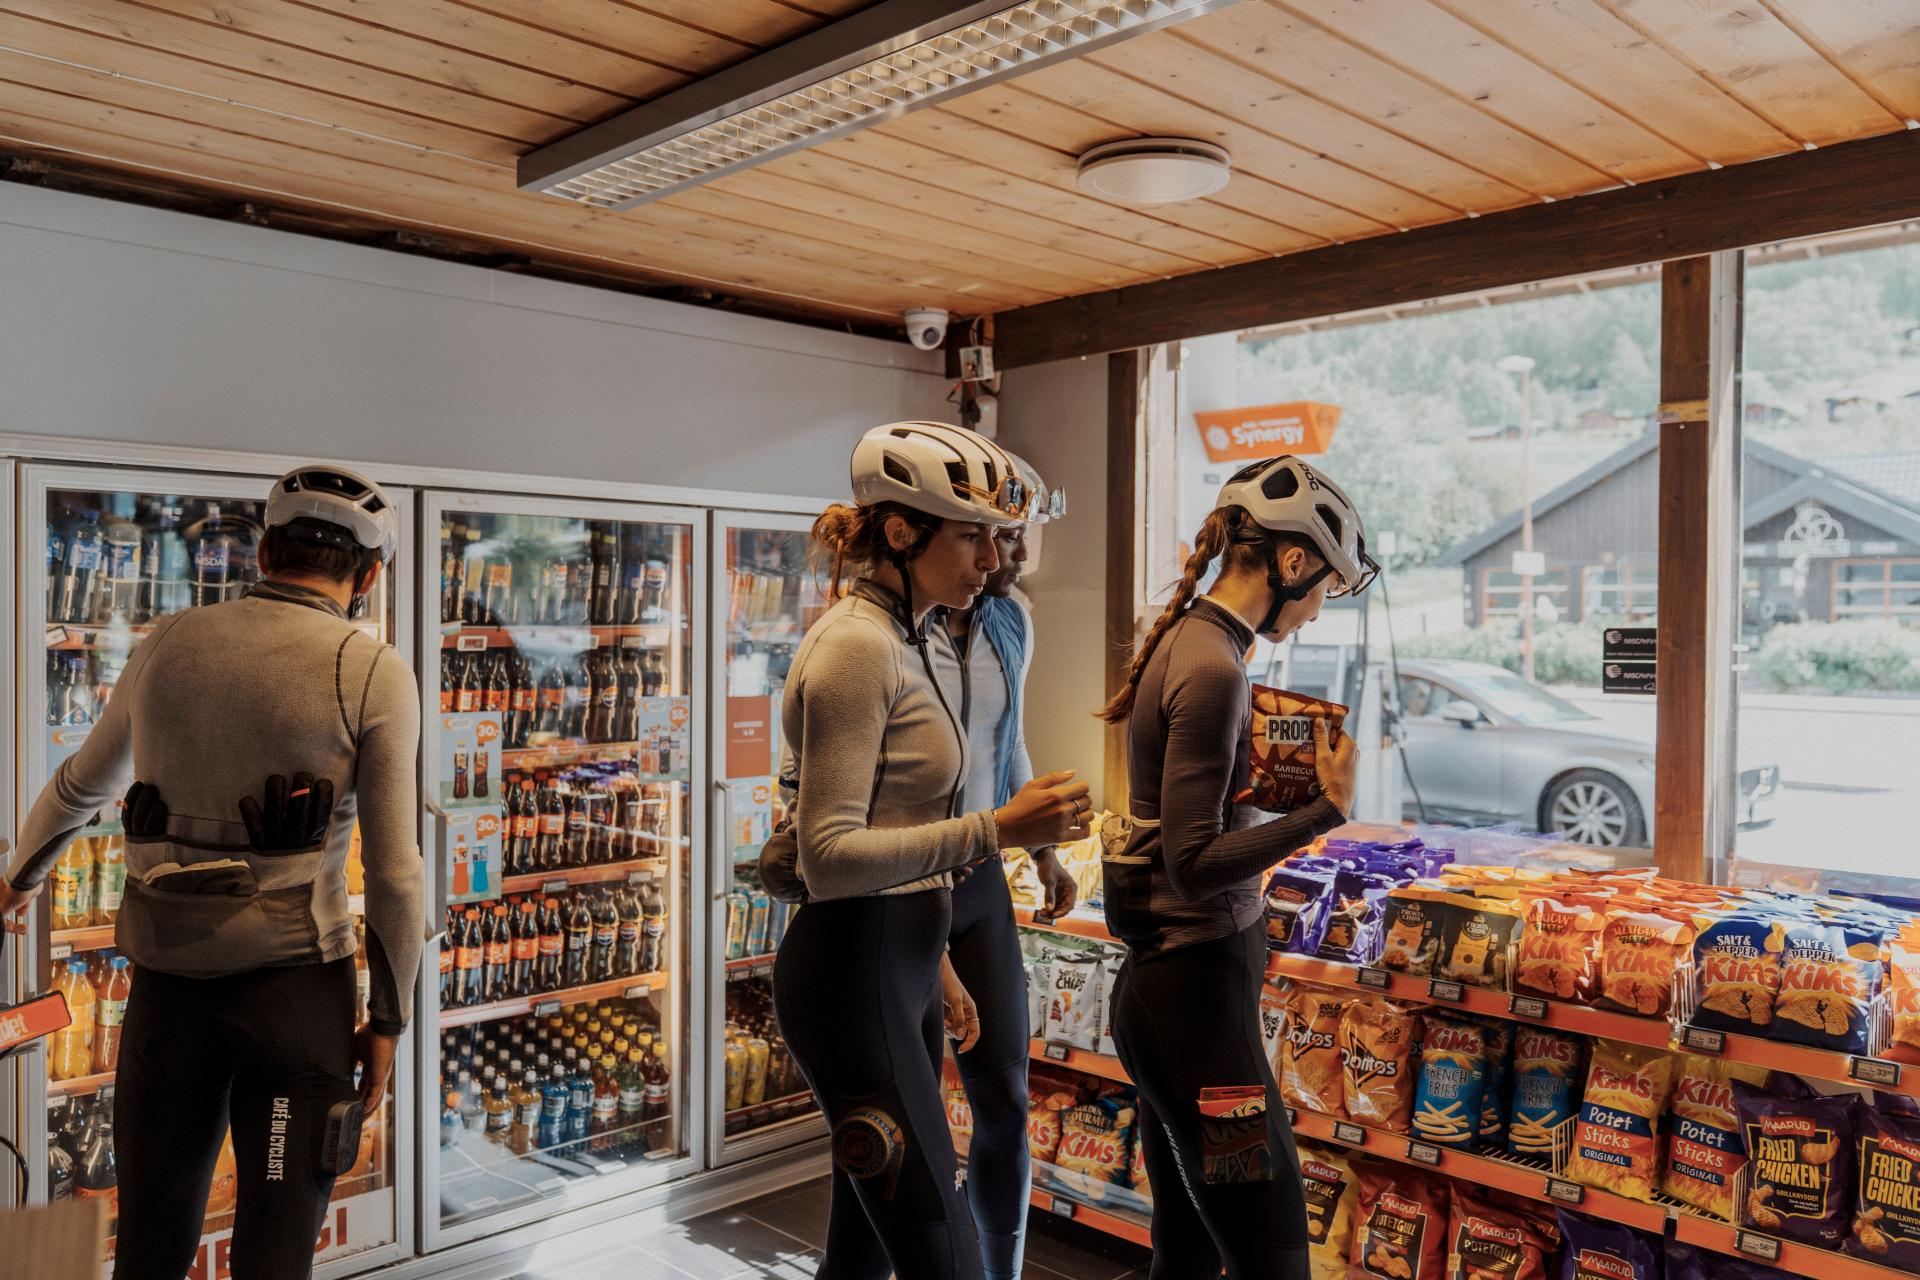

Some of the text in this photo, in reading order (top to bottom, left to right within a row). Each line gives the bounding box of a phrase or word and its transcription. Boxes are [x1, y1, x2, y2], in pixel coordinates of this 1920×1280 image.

[1232, 424, 1304, 448] Synergy
[1297, 463, 1319, 491] POC
[1274, 763, 1315, 776] BARBECUE
[1528, 911, 1571, 925] MXICAN
[1713, 945, 1758, 958] PEPPER
[1790, 949, 1838, 963] PEPPER
[1056, 977, 1086, 992] CHIPS
[1319, 1002, 1342, 1010] BOLD
[1425, 1064, 1468, 1085] FRENCH
[1429, 1080, 1459, 1098] FRIES
[1519, 1076, 1561, 1094] FRENCH
[1522, 1091, 1553, 1109] FRIES
[1589, 1106, 1633, 1131] Potet
[1763, 1119, 1811, 1132] MAARUD
[266, 1097, 291, 1181] CAFÉ DU CYCLISTE
[1584, 1126, 1630, 1149] Sticks
[1680, 1121, 1726, 1148] Potet
[1584, 1149, 1626, 1166] ORIGINAL
[1675, 1140, 1724, 1168] Sticks
[1758, 1137, 1796, 1162] FRIED
[1302, 1163, 1338, 1179] MAARUD
[1675, 1163, 1718, 1184] ORIGINAL
[1757, 1160, 1820, 1189] CHICKEN
[1870, 1152, 1913, 1183] FRIED
[1383, 1198, 1416, 1214] MAARUD
[1471, 1223, 1516, 1240] MAARUD
[1464, 1239, 1518, 1265] POTETGULL
[1584, 1255, 1631, 1277] MAARUD
